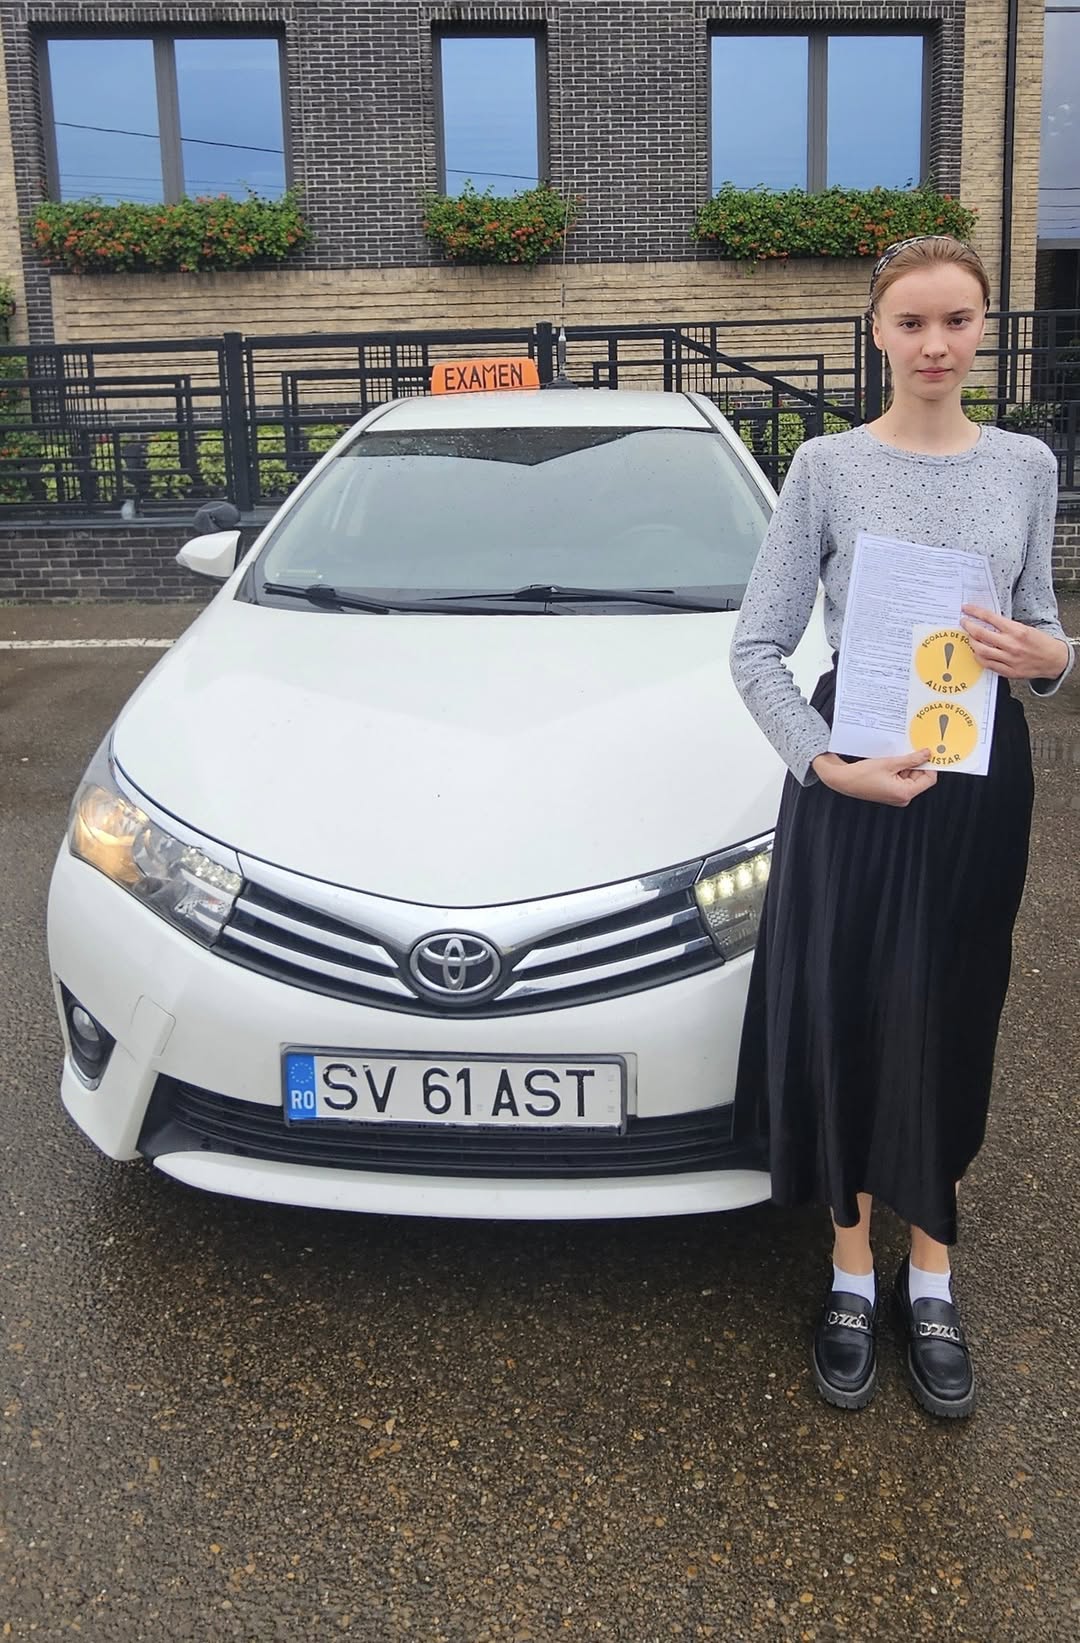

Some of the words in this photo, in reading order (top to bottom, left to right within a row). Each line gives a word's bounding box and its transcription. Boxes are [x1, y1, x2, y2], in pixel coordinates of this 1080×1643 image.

[444, 363, 523, 391] EXAMEN
[950, 631, 959, 639] DE
[925, 680, 968, 694] ALISTAR
[927, 753, 961, 765] ISTAR
[322, 1063, 397, 1113] SV
[422, 1067, 472, 1115] 61
[491, 1068, 595, 1117] AST
[291, 1089, 315, 1110] RO
